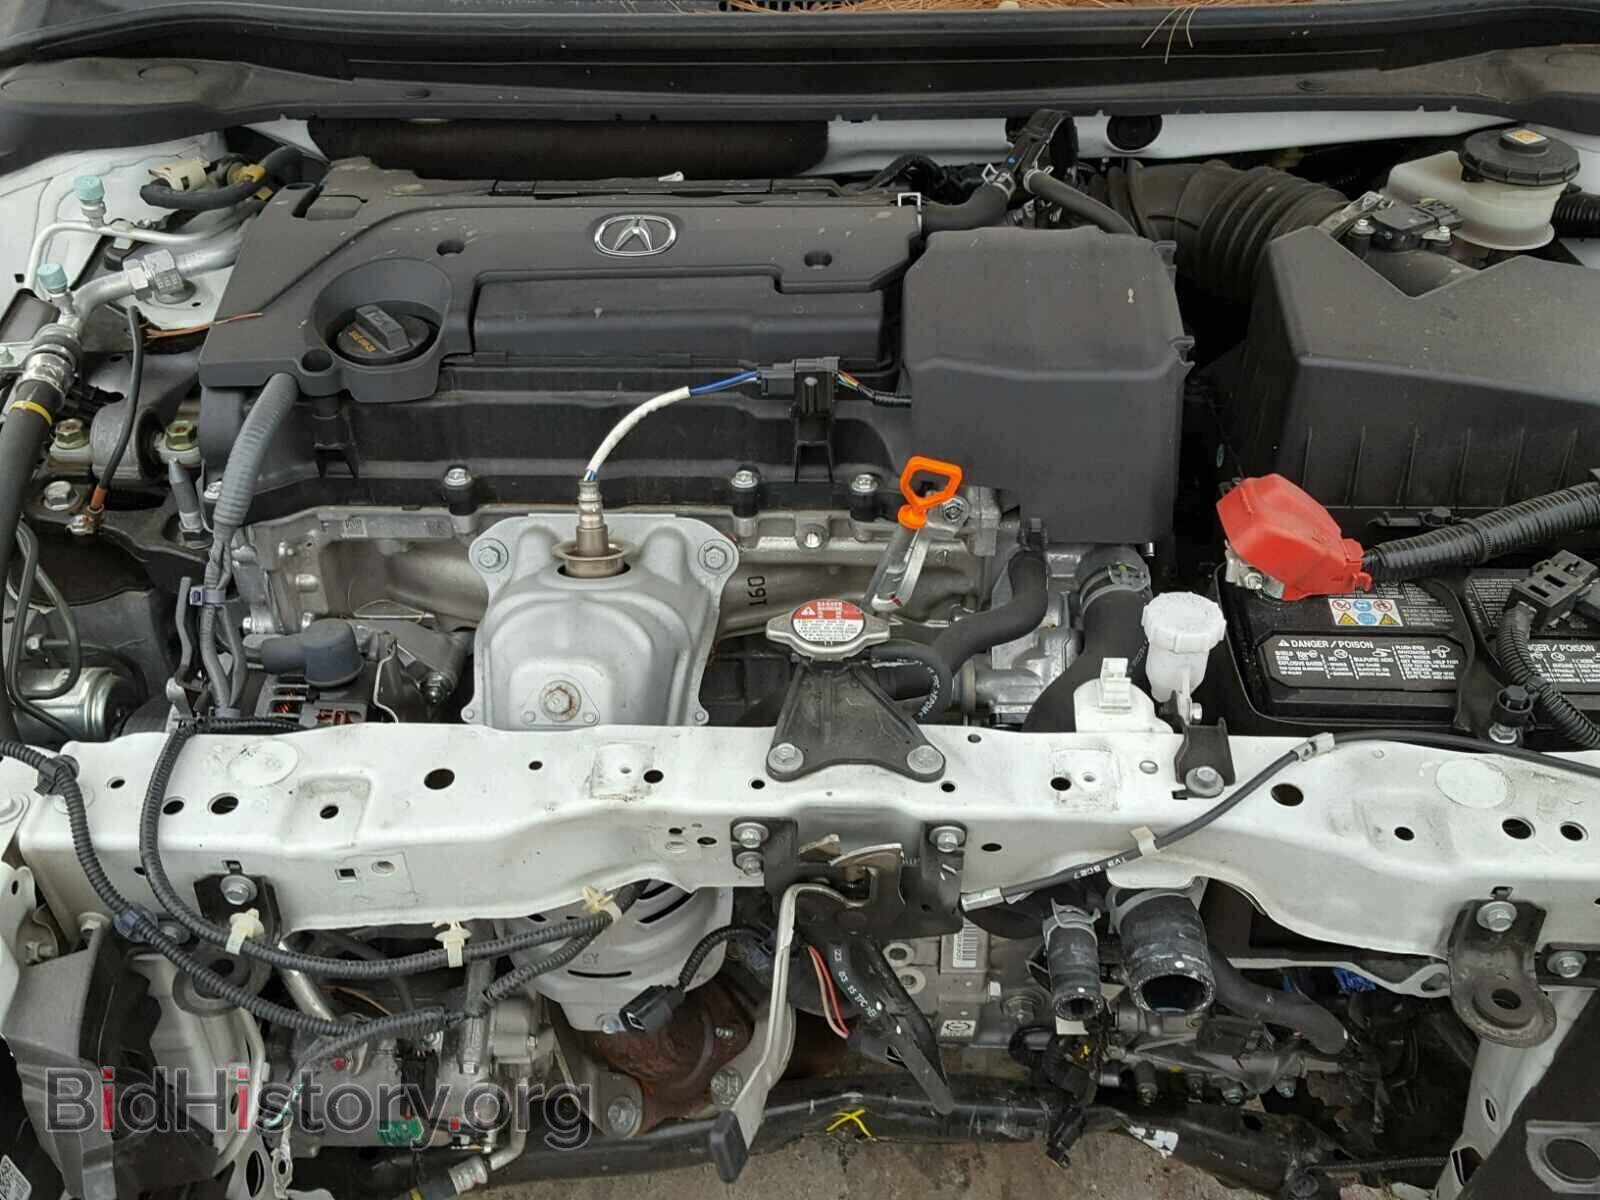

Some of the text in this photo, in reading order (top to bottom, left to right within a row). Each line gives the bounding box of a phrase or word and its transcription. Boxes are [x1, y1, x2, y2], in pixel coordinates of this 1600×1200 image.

[747, 575, 767, 606] 160
[1290, 639, 1329, 648] DANGER
[1338, 640, 1374, 649] POISON
[1559, 644, 1595, 653] POISON
